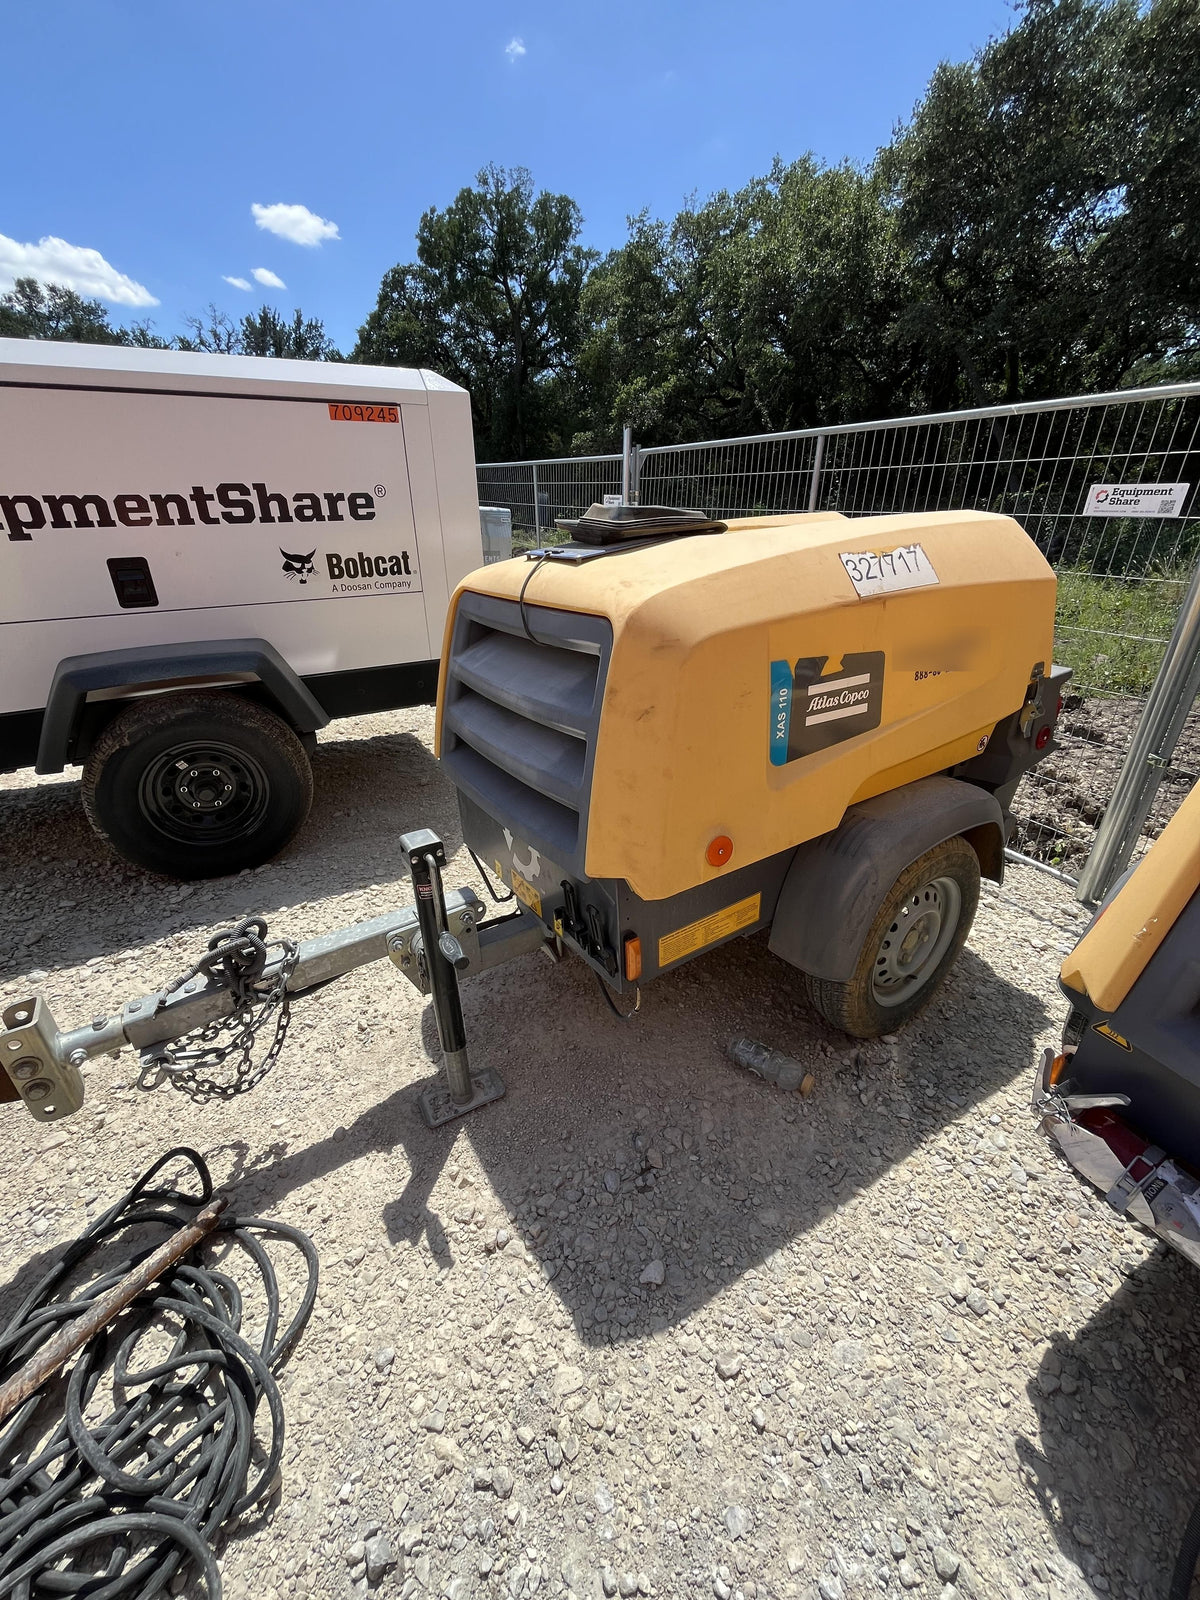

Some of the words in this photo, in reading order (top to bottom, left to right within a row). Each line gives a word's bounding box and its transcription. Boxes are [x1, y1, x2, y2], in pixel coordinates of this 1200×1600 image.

[330, 404, 397, 423] 709245
[1108, 497, 1140, 506] Share
[1111, 487, 1173, 497] Equipment
[0, 483, 376, 541] pmentShare
[325, 550, 411, 579] Bobcat
[332, 584, 339, 592] A
[341, 583, 372, 592] Doosan
[374, 580, 412, 590] Company
[778, 688, 788, 709] 110
[806, 695, 840, 712] Atlas
[840, 689, 870, 705] Copco
[776, 711, 787, 739] XAS
